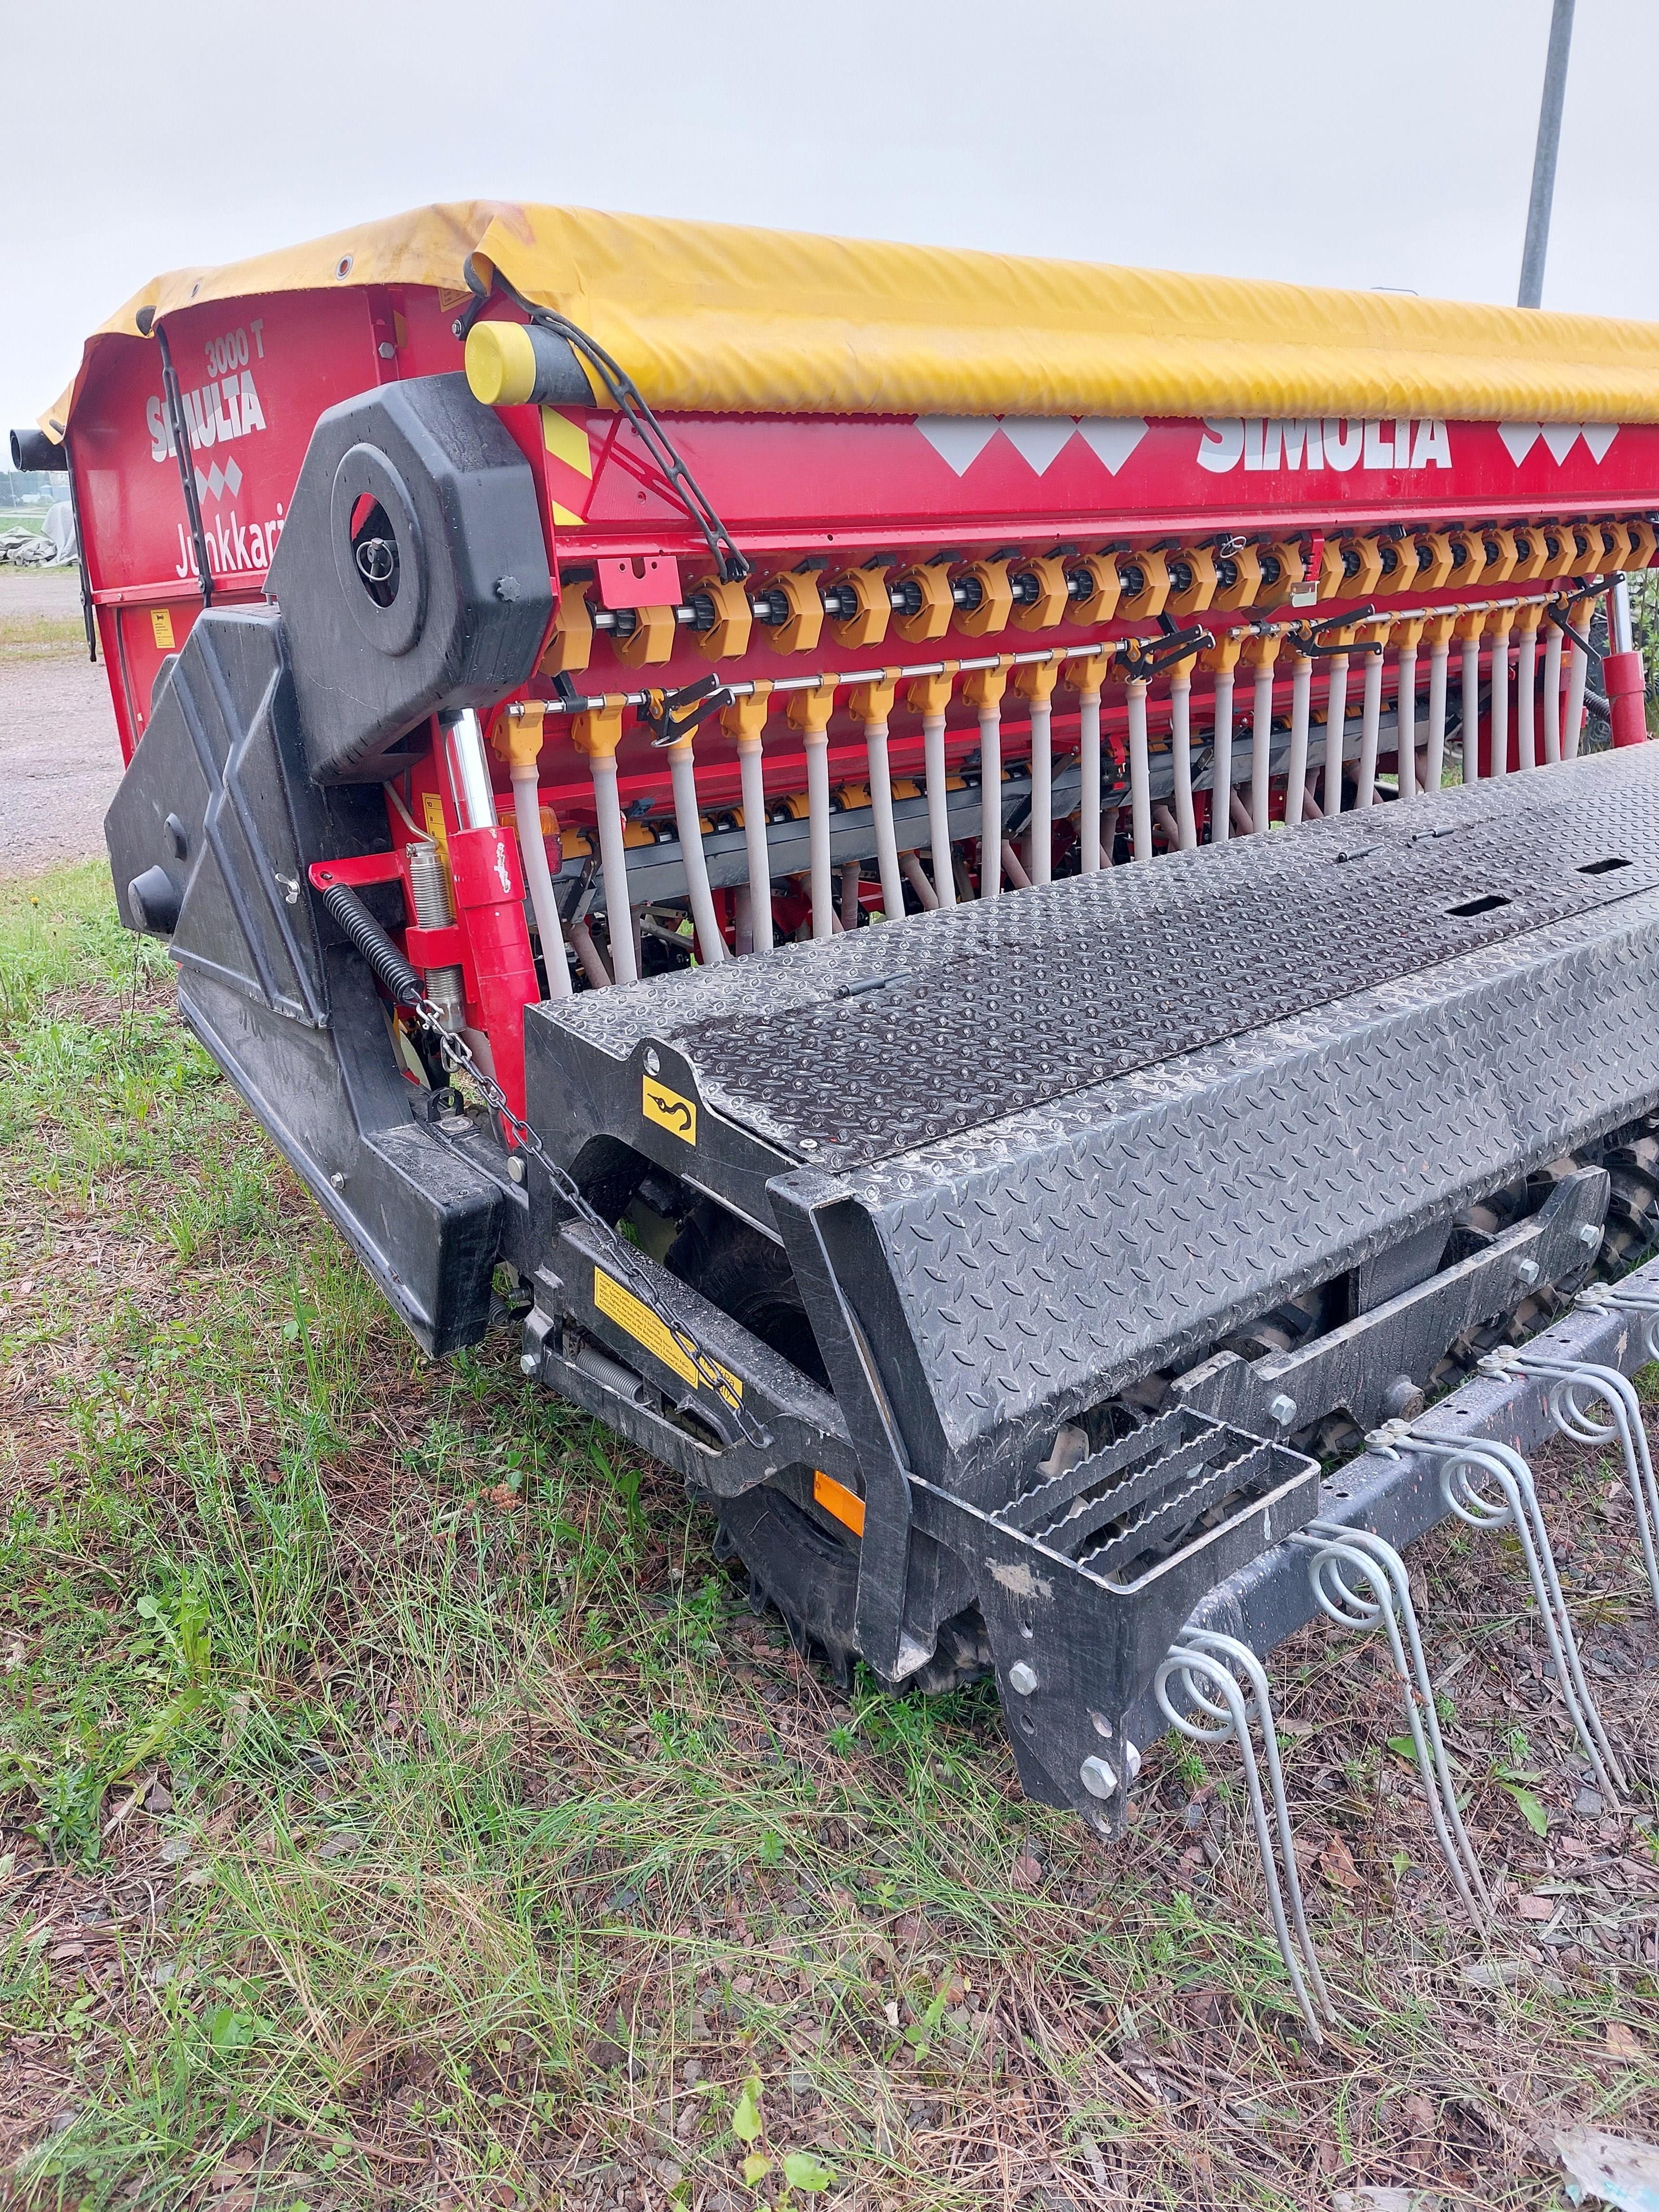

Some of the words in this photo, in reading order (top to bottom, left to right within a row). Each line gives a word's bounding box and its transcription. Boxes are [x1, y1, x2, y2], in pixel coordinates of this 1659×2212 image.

[205, 327, 249, 378] 3000
[250, 318, 264, 358] T
[146, 370, 266, 463] SIMULTA
